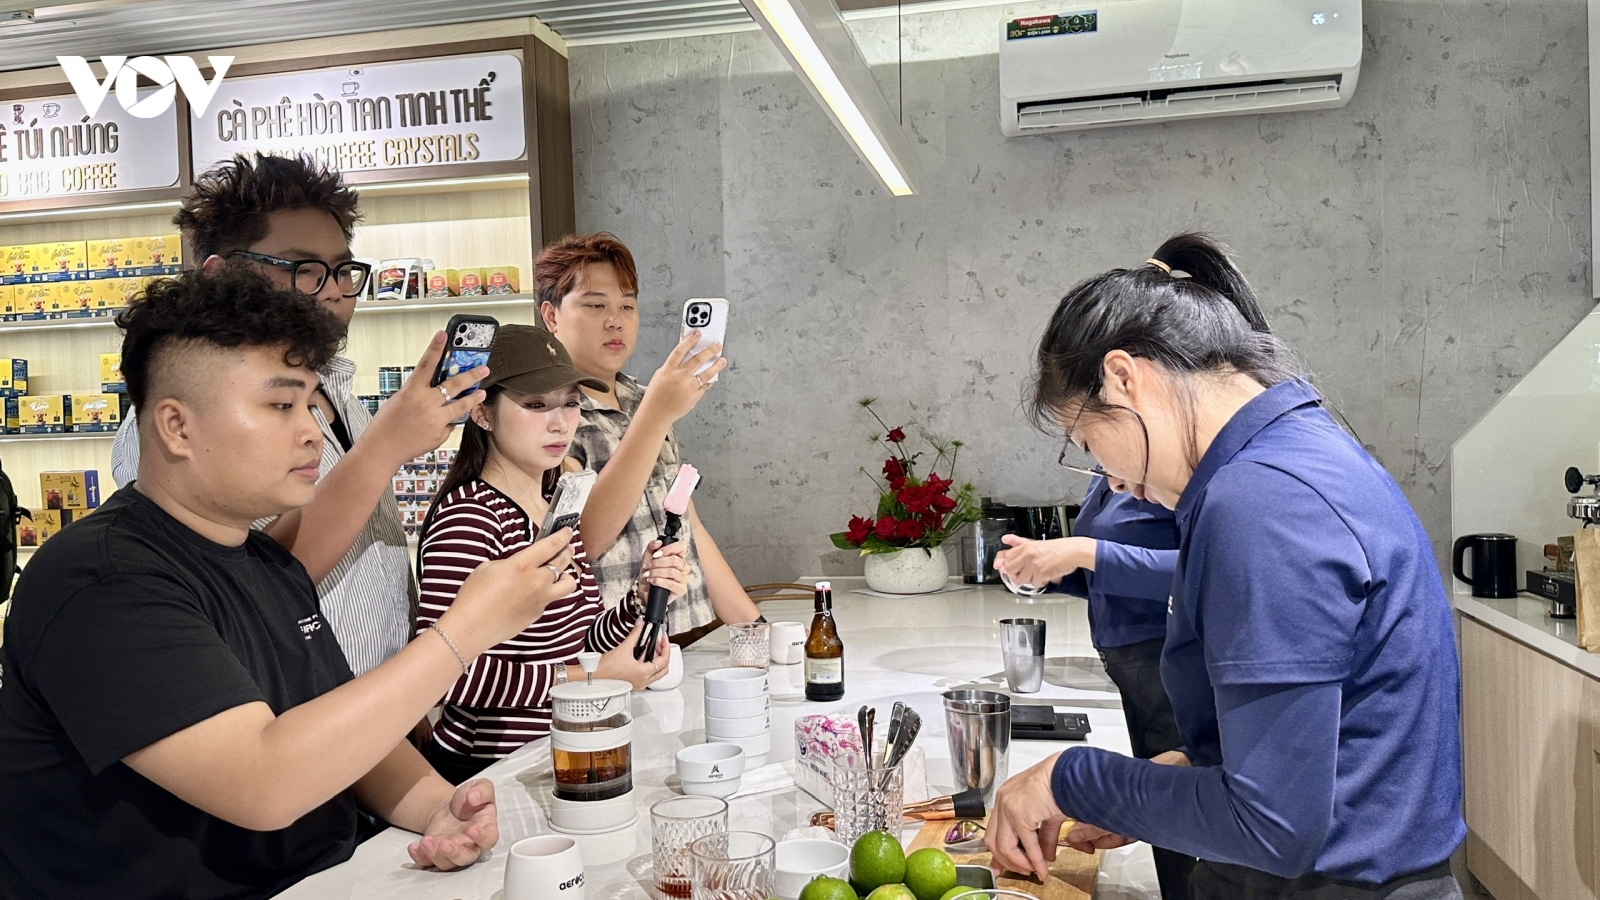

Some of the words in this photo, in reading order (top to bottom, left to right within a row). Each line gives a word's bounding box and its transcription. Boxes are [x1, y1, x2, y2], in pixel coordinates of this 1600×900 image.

[1020, 18, 1051, 26] Nagakawa
[1311, 12, 1325, 26] 26
[1164, 52, 1190, 60] Nagakawa
[217, 99, 247, 142] CÀ
[251, 96, 293, 139] PHÊ
[296, 93, 343, 136] HÒA
[346, 96, 392, 132] TAN
[395, 90, 448, 127] TINH
[449, 71, 497, 123] THỂ
[14, 117, 44, 160] TÚI
[50, 115, 119, 158] NHÚNG
[382, 132, 480, 166] CRYSTALS
[61, 162, 117, 192] COFFEE
